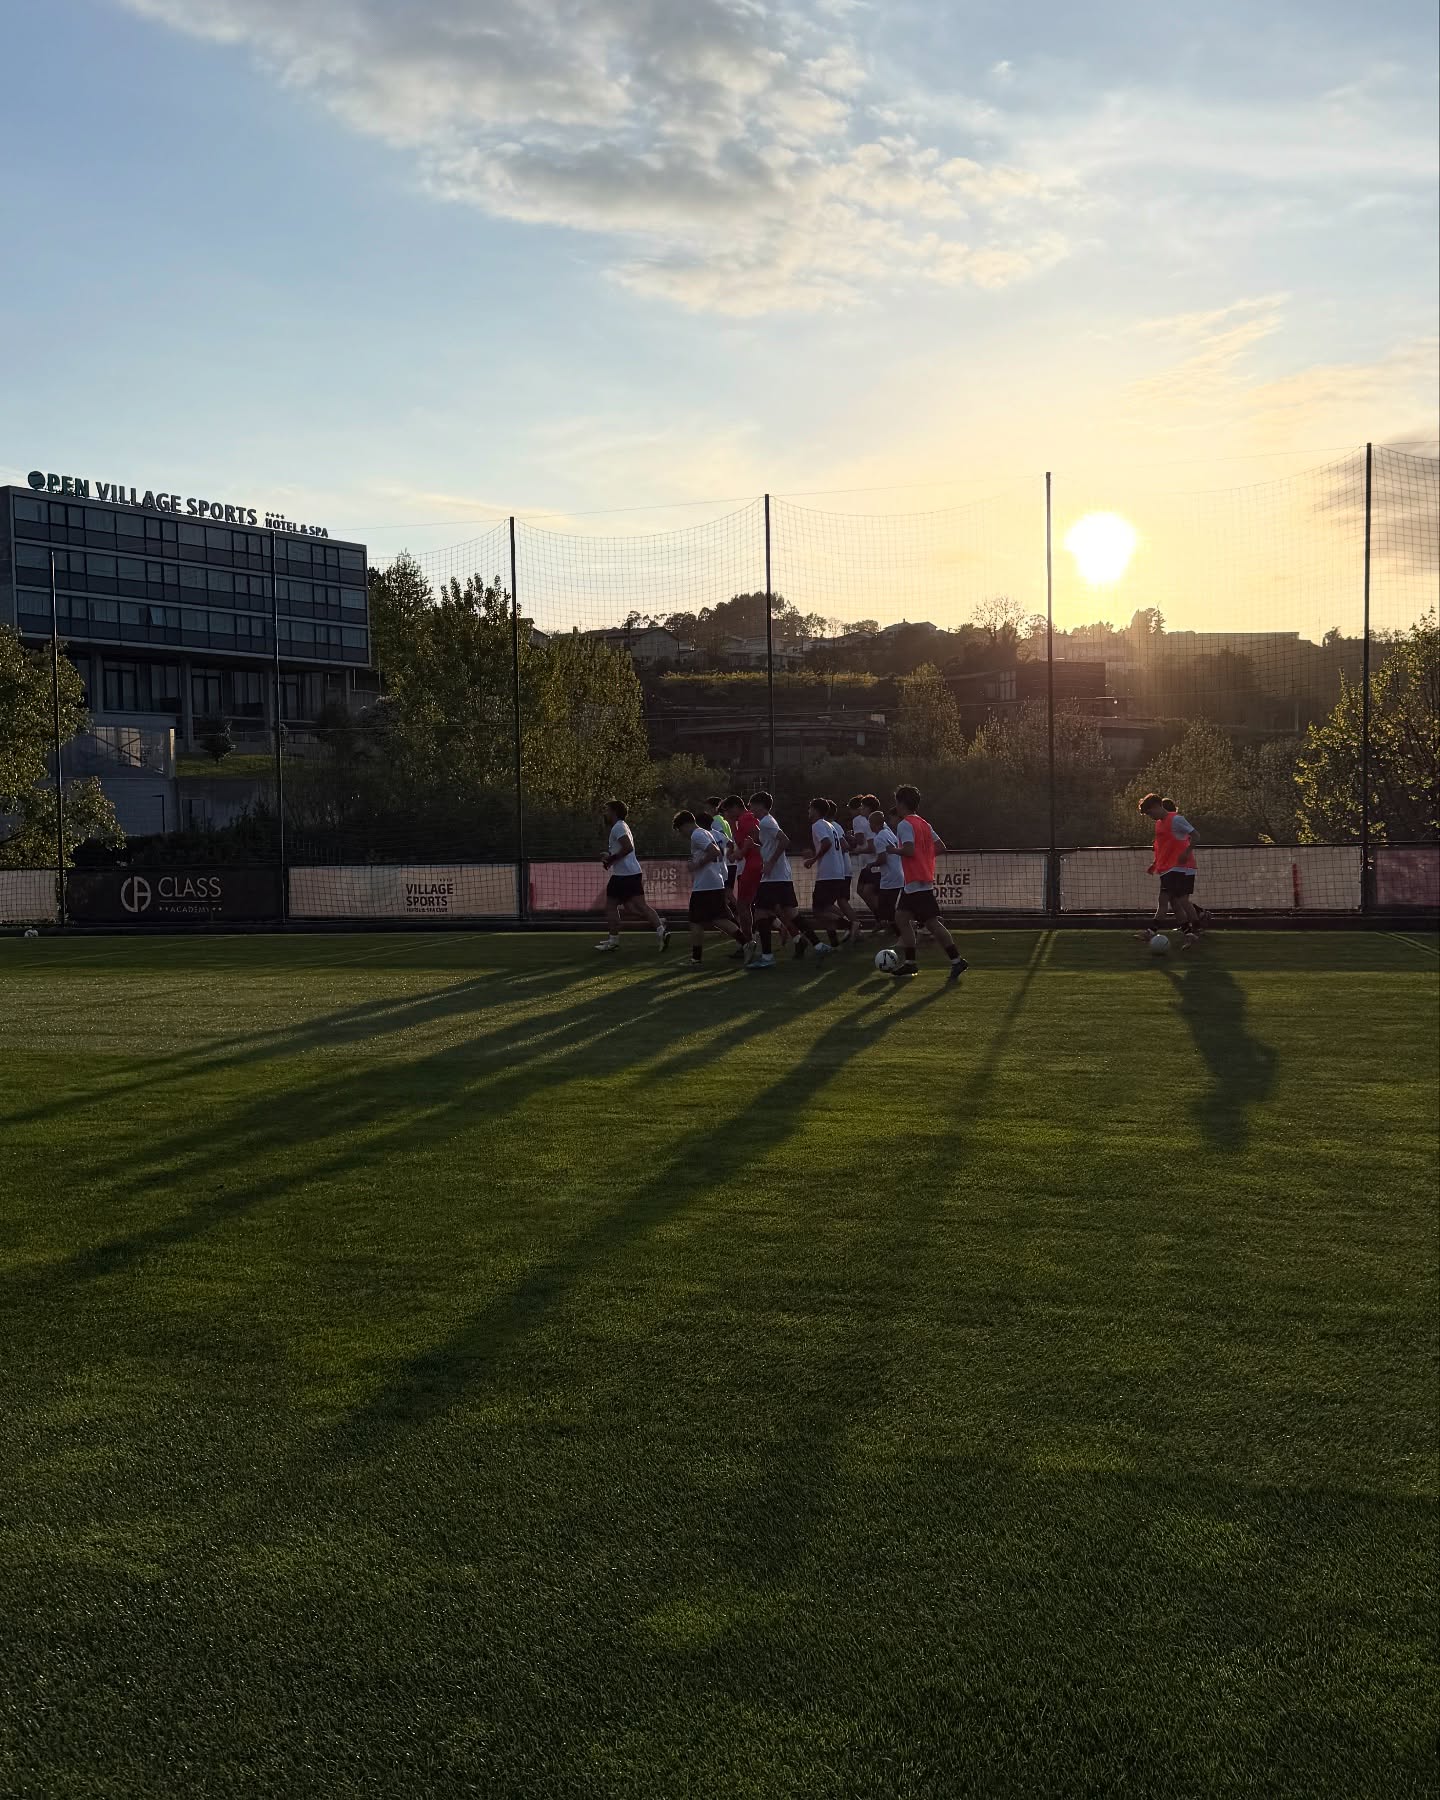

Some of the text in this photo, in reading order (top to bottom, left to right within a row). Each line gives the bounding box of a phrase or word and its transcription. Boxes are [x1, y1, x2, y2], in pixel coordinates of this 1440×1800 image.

[95, 481, 182, 513] VILLAGE
[186, 497, 258, 526] SPORTS
[265, 517, 298, 533] HOTEL
[309, 526, 329, 538] SPA
[652, 867, 677, 880] DOS
[933, 873, 970, 885] LAGE
[157, 876, 222, 898] CLASS
[406, 883, 453, 894] VILLAGE
[933, 886, 962, 898] ORTS
[406, 896, 448, 906] SPORTS
[169, 905, 210, 913] ACADEMY
